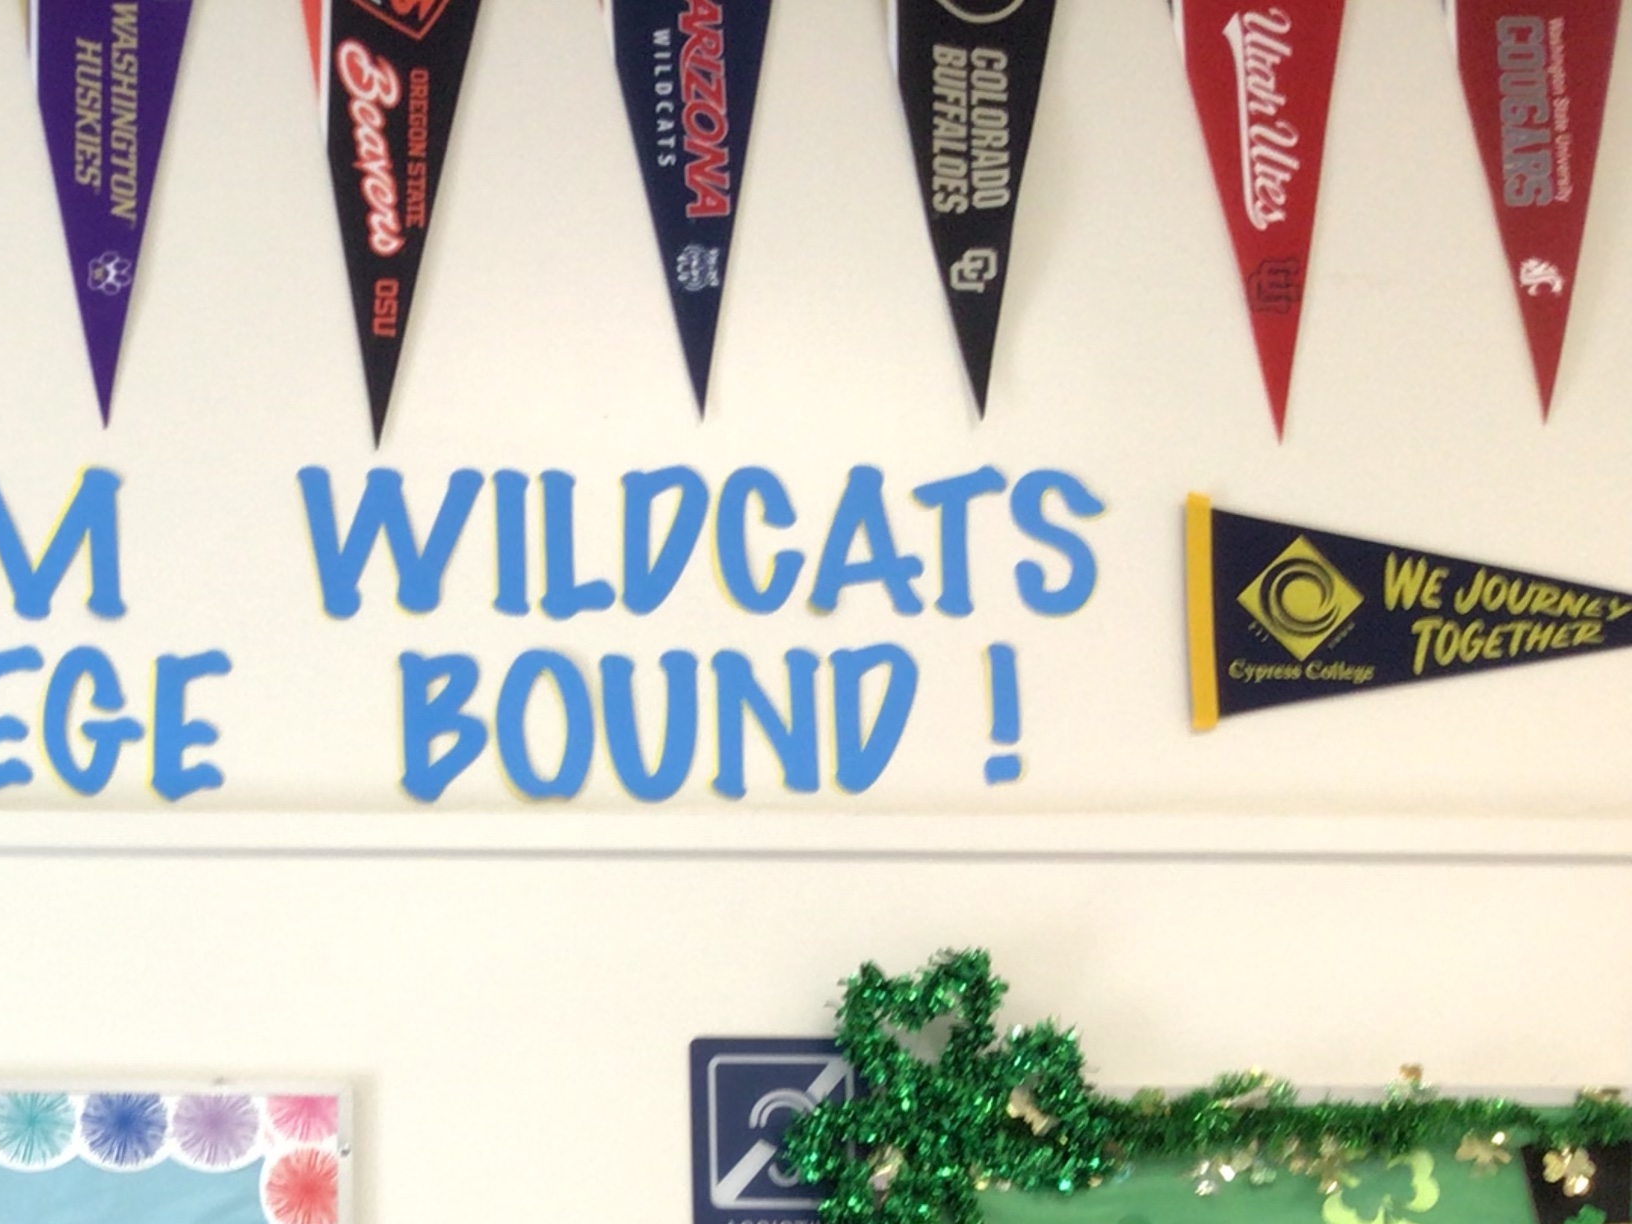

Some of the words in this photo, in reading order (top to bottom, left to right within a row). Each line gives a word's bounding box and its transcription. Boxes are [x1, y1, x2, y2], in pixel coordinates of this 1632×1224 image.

[110, 1, 139, 221] WASHINGTON
[652, 28, 676, 168] WILDCATS
[678, 0, 731, 218] ARIZONA
[1240, 7, 1293, 118] Utah
[1548, 16, 1566, 95] Washington
[74, 37, 102, 188] HUSKIES
[335, 39, 406, 257] Beavers
[408, 68, 429, 157] OREGON
[932, 44, 970, 214] BUFFALOES
[970, 47, 1010, 210] COLORADO
[1496, 16, 1553, 207] COUGARS
[1552, 96, 1570, 132] State
[405, 162, 427, 228] STATE
[1242, 120, 1300, 228] Utes
[1554, 133, 1573, 202] University
[372, 278, 398, 338] OSU
[296, 463, 1106, 622] WILDCATS
[1384, 551, 1450, 611] WE
[1453, 566, 1632, 621] JOURNEY
[1228, 658, 1302, 684] Cypress
[1305, 660, 1376, 685] College
[1411, 616, 1605, 676] TOGETHER
[397, 641, 919, 803] BOUND
